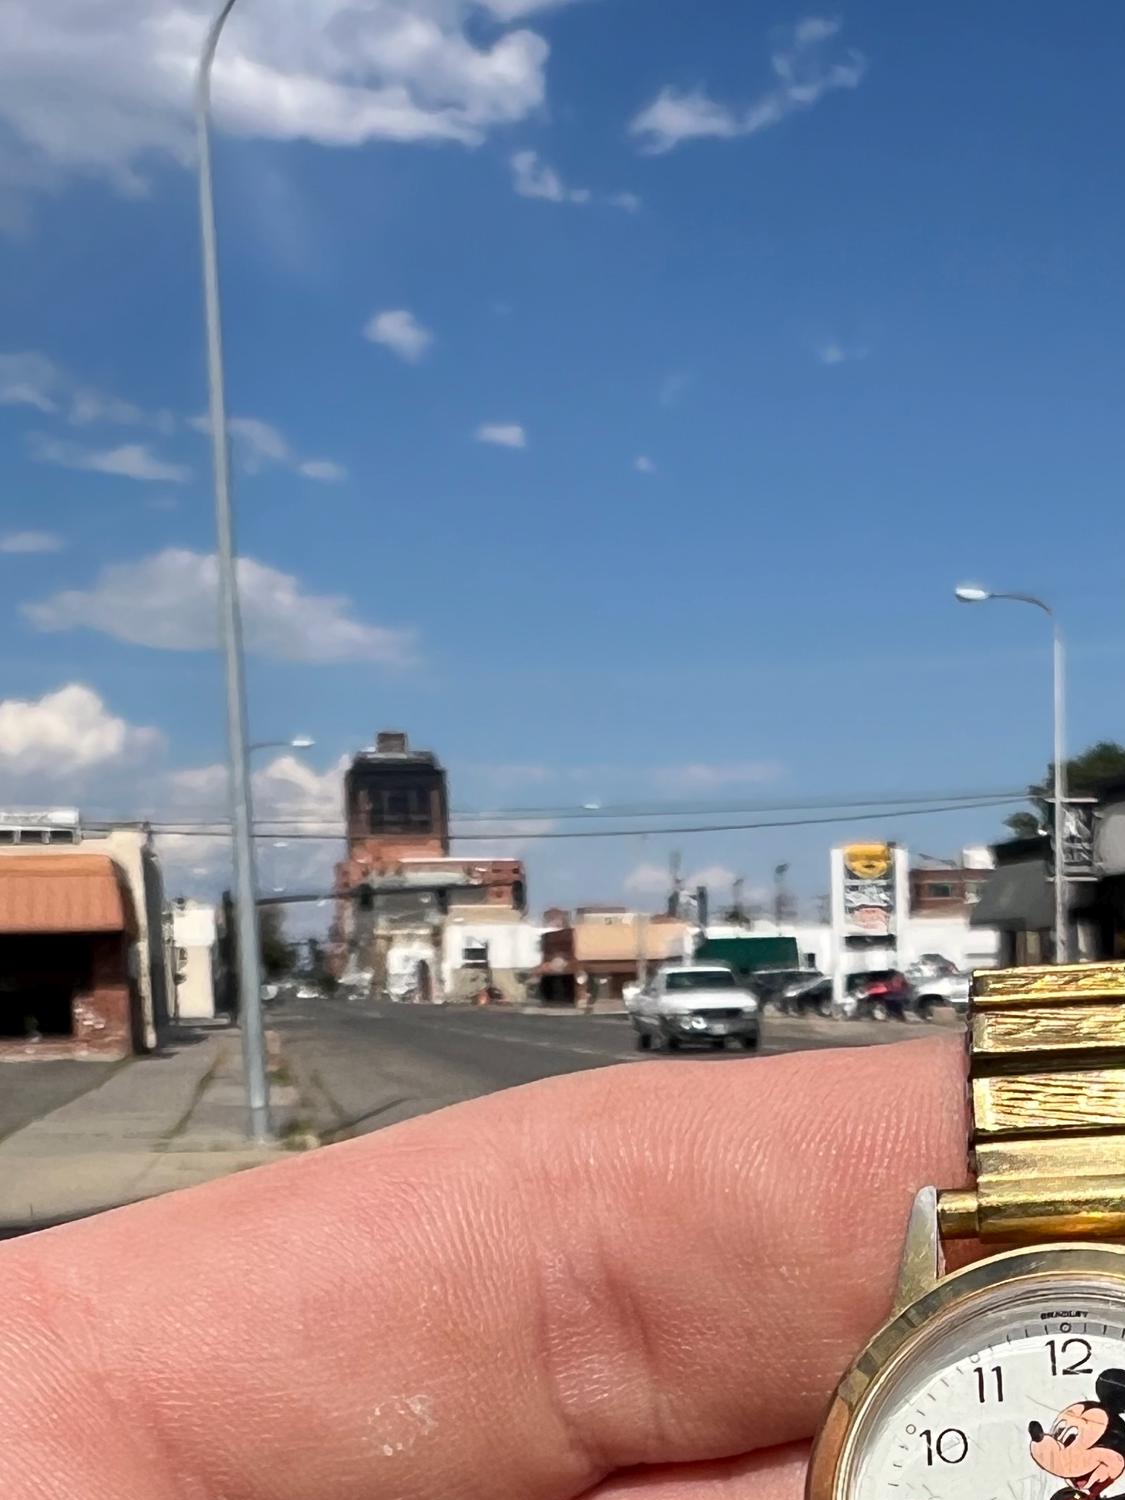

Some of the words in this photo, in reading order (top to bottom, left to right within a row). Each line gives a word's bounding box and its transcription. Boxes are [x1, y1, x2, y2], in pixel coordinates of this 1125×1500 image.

[1045, 1339, 1093, 1376] 12
[974, 1366, 1003, 1403] 11
[919, 1428, 968, 1466] 10
